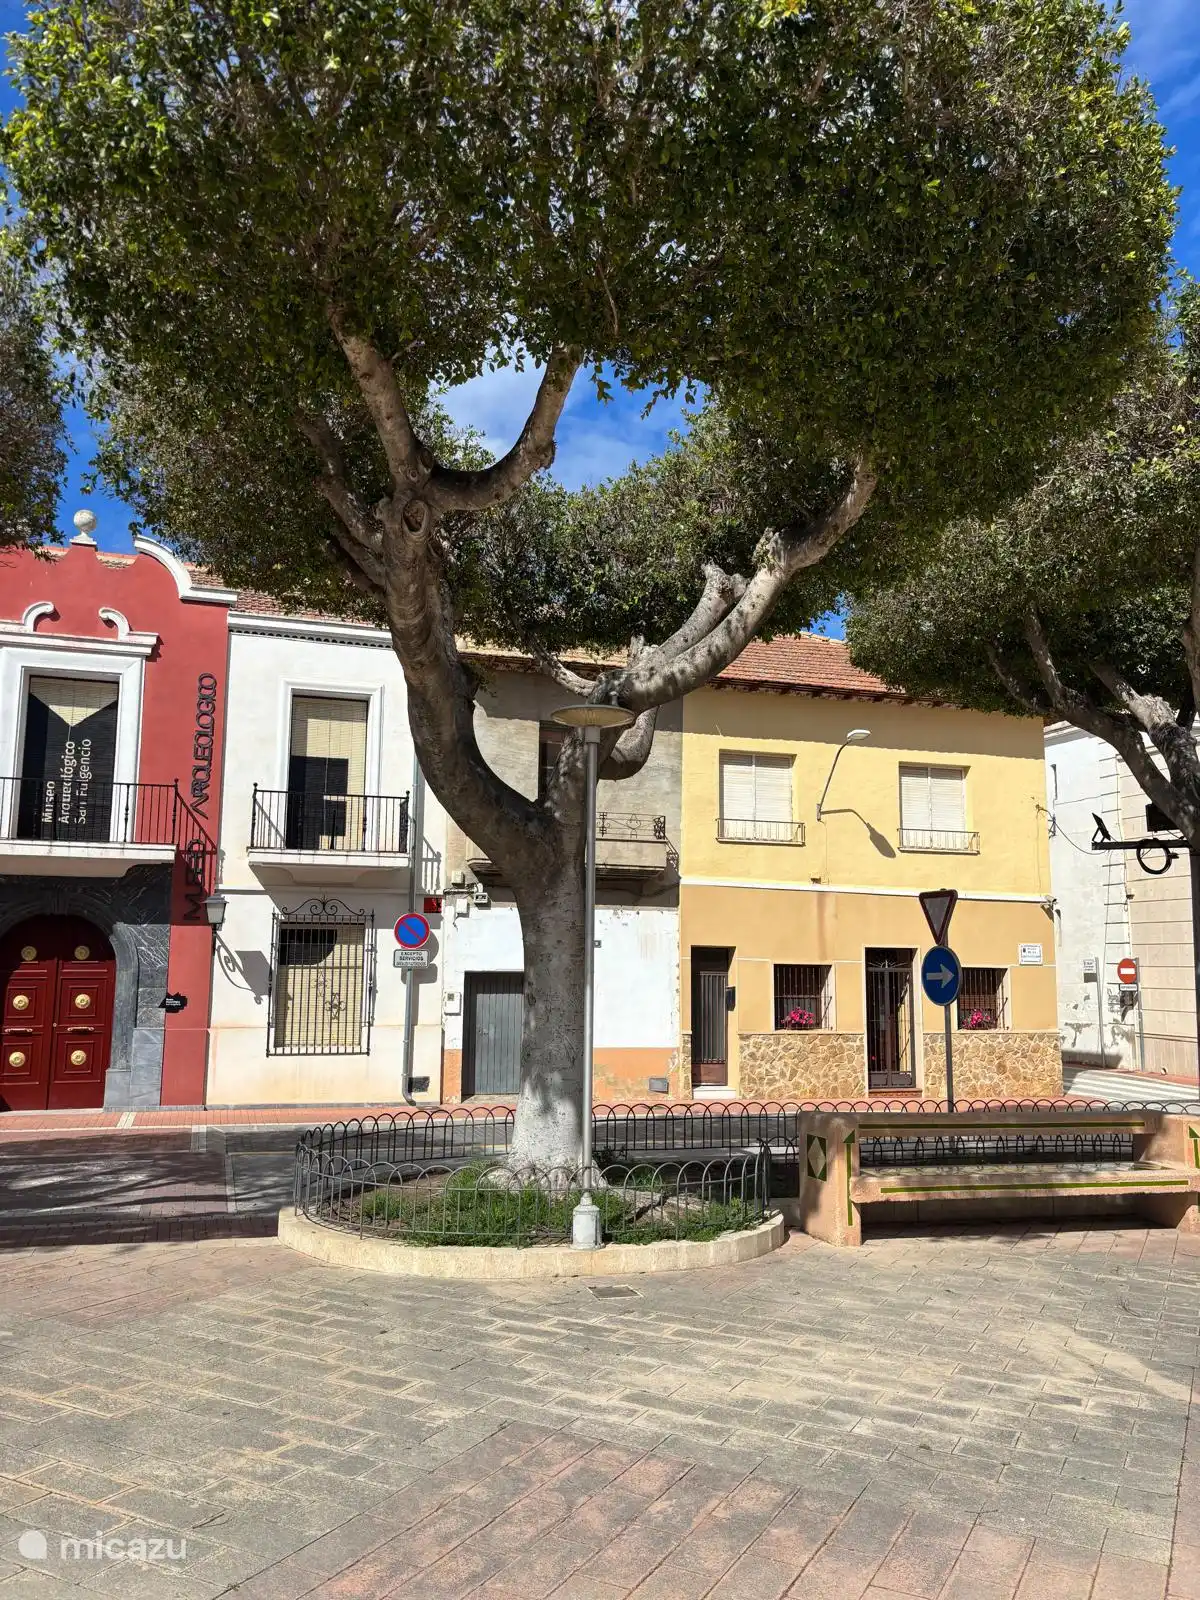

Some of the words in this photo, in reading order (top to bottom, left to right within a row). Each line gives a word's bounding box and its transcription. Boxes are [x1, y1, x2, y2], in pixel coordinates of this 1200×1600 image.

[58, 741, 76, 824] Arqueológico
[76, 738, 92, 796] Fulgencio
[42, 781, 55, 823] Museo
[74, 802, 87, 825] San
